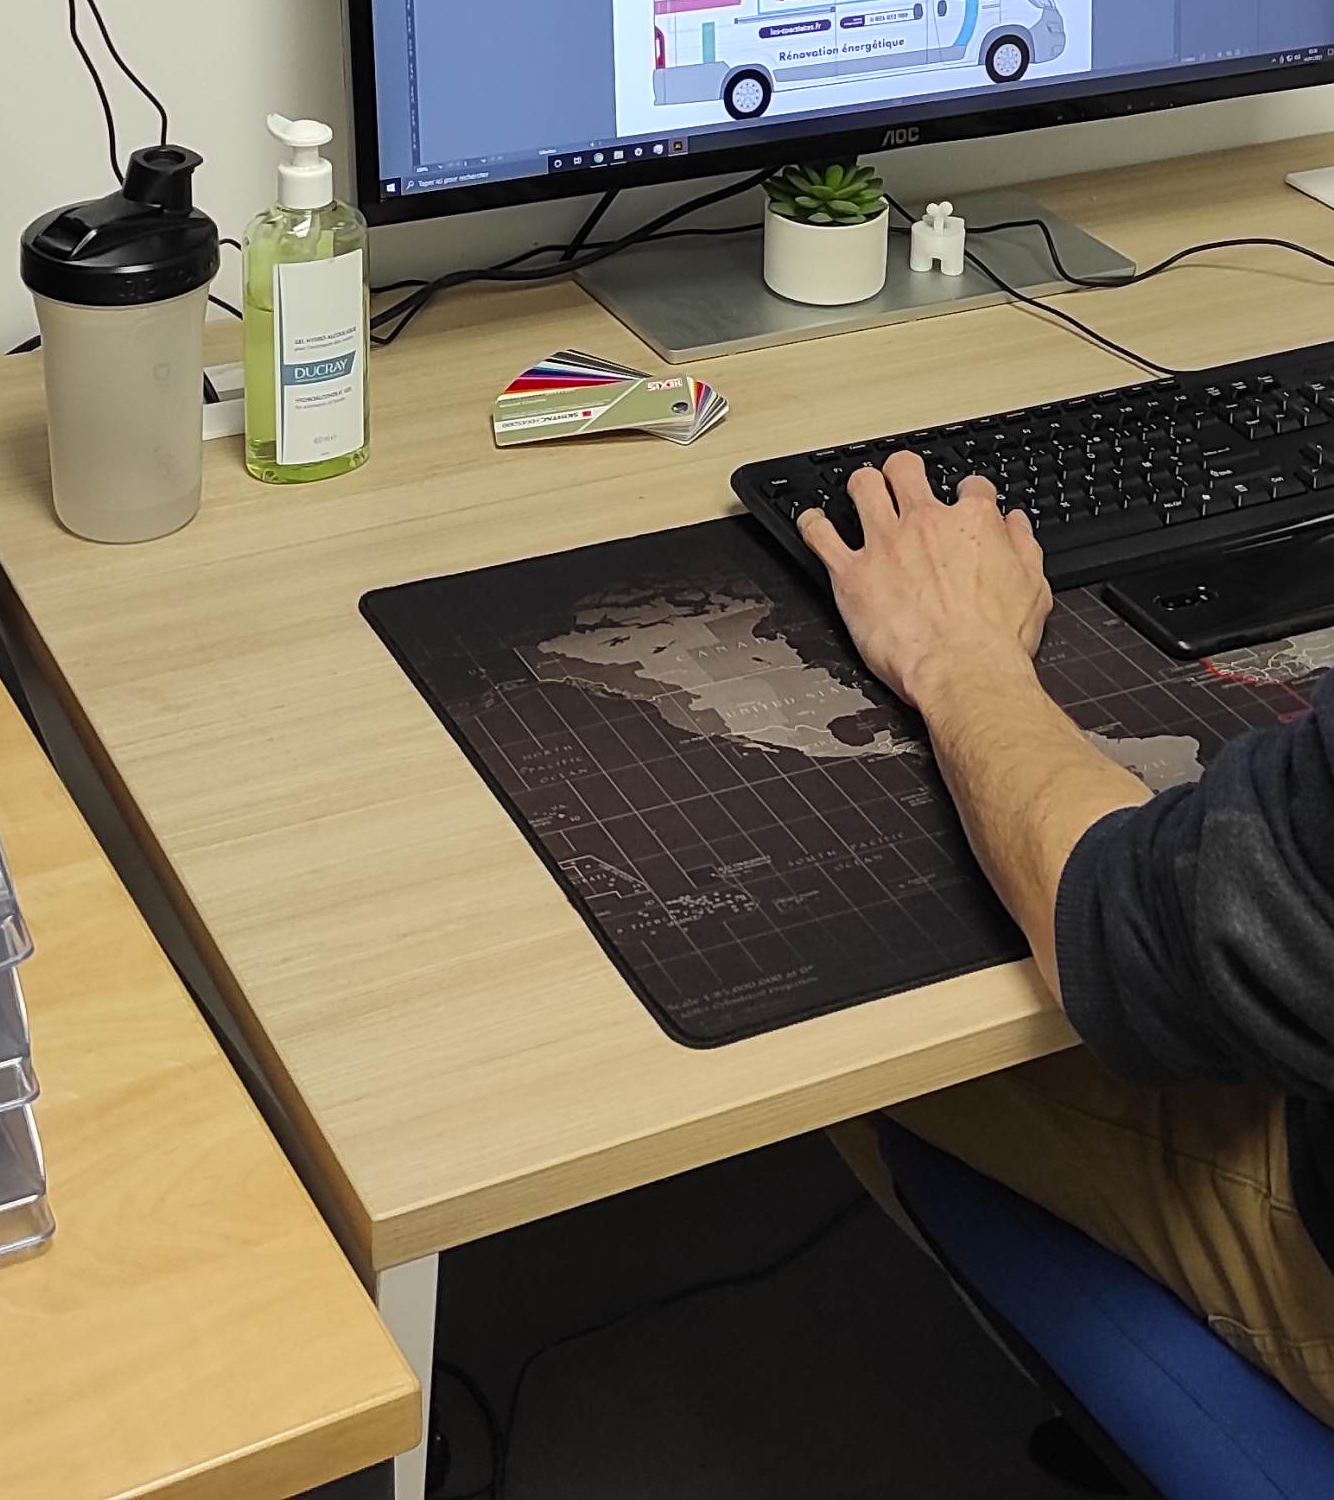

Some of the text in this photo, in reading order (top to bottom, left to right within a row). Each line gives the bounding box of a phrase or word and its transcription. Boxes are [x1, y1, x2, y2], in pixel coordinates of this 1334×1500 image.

[779, 39, 905, 62] Rénovation énergétique
[881, 127, 920, 147] AOC
[294, 358, 348, 380] DUCRAY
[675, 631, 788, 663] CANADA
[539, 768, 588, 786] OCEAN
